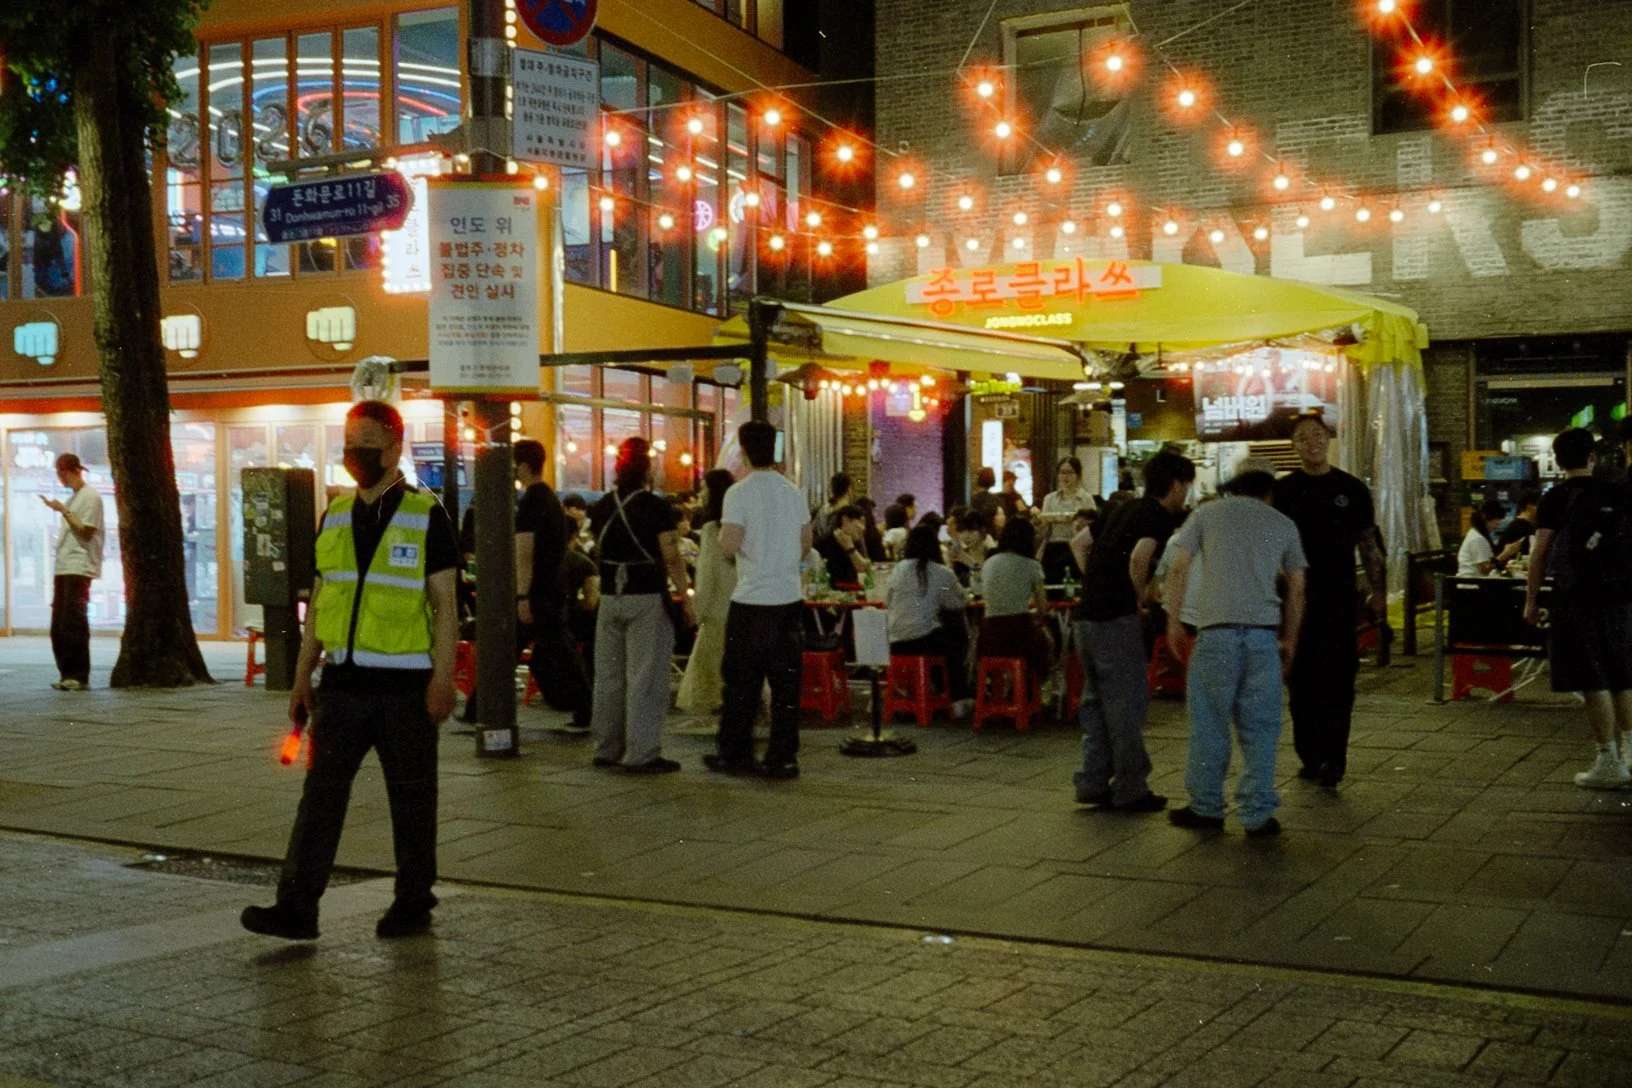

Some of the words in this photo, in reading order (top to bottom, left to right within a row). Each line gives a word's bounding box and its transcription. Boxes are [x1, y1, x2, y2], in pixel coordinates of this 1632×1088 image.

[292, 179, 376, 207] 돈화문로11길
[269, 208, 281, 222] 31
[285, 208, 356, 224] Donhwamun-ro
[357, 201, 384, 217] 11-gil
[386, 194, 400, 209] 35
[450, 217, 487, 235] 인도
[496, 217, 512, 235] 위
[439, 241, 525, 259] 불법주·정차
[441, 263, 470, 279] 집중
[475, 263, 504, 279] 단속
[511, 265, 522, 279] 및
[451, 283, 480, 300] 견인
[486, 283, 516, 300] 실시
[921, 256, 1141, 317] 종로클라쓰
